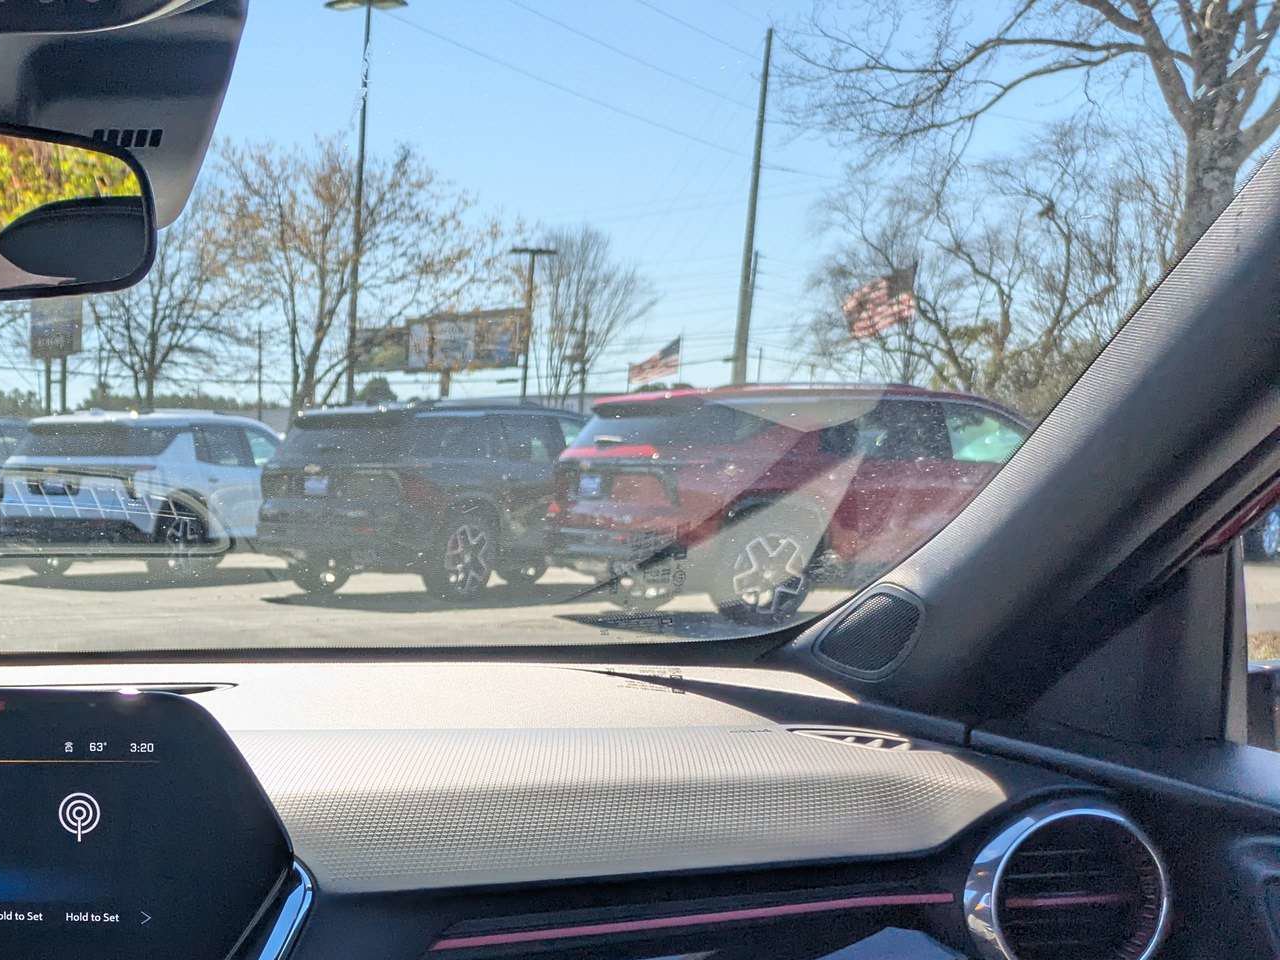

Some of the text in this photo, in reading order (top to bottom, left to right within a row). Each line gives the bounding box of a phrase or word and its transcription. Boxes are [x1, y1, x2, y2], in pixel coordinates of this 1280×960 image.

[130, 743, 154, 752] 3:20
[15, 912, 25, 921] to
[27, 912, 43, 921] Set
[66, 912, 120, 922] Hold to Set
